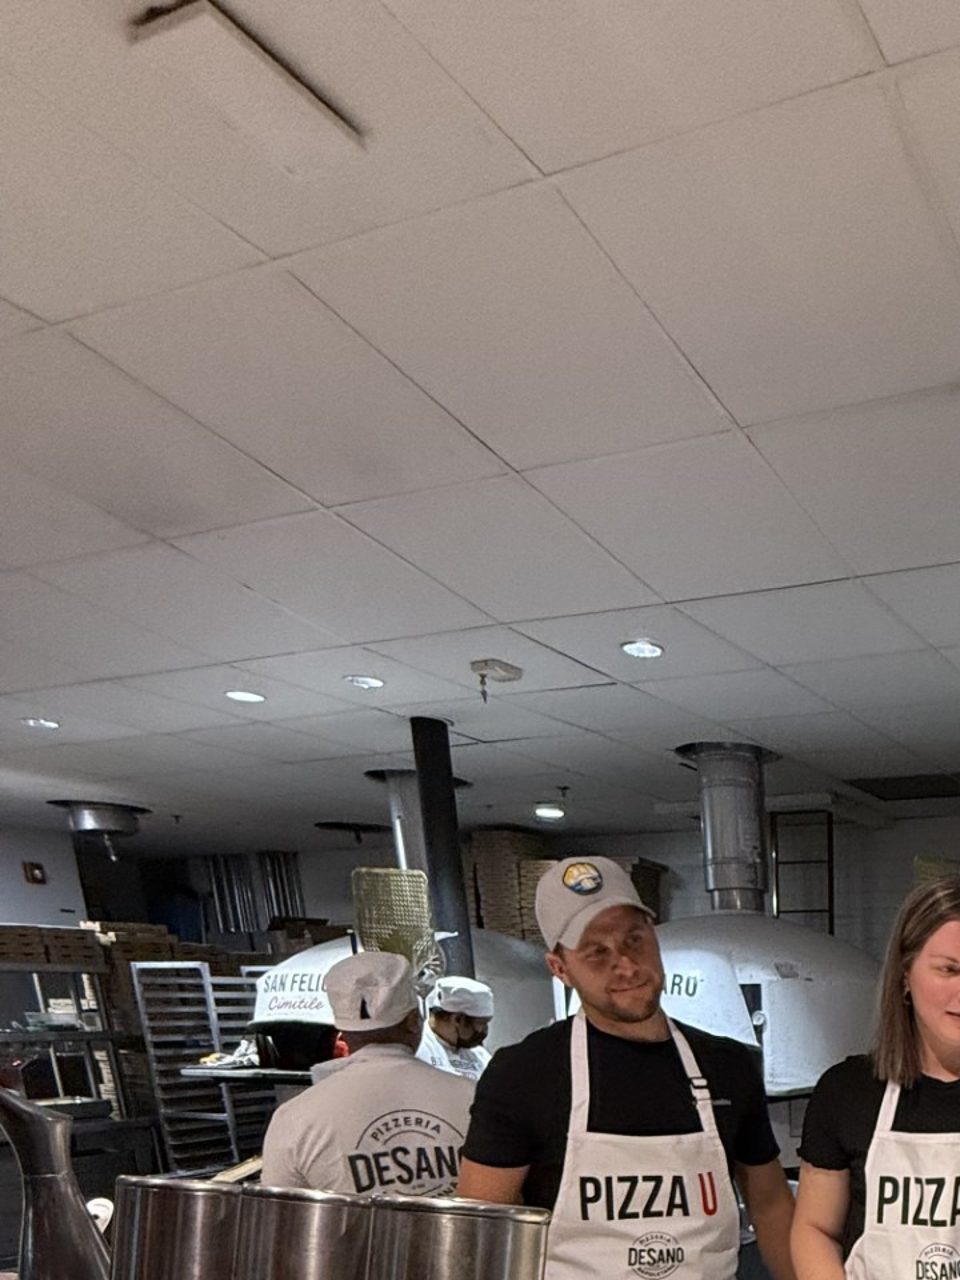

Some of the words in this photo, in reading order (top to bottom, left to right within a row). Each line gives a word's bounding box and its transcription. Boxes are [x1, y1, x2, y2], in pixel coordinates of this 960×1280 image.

[263, 974, 288, 993] SAN
[371, 1116, 441, 1142] PIZZERIA
[347, 1145, 462, 1194] DESAN
[579, 1175, 690, 1221] PIZZA
[698, 1171, 718, 1216] U
[628, 1247, 685, 1266] DESANO
